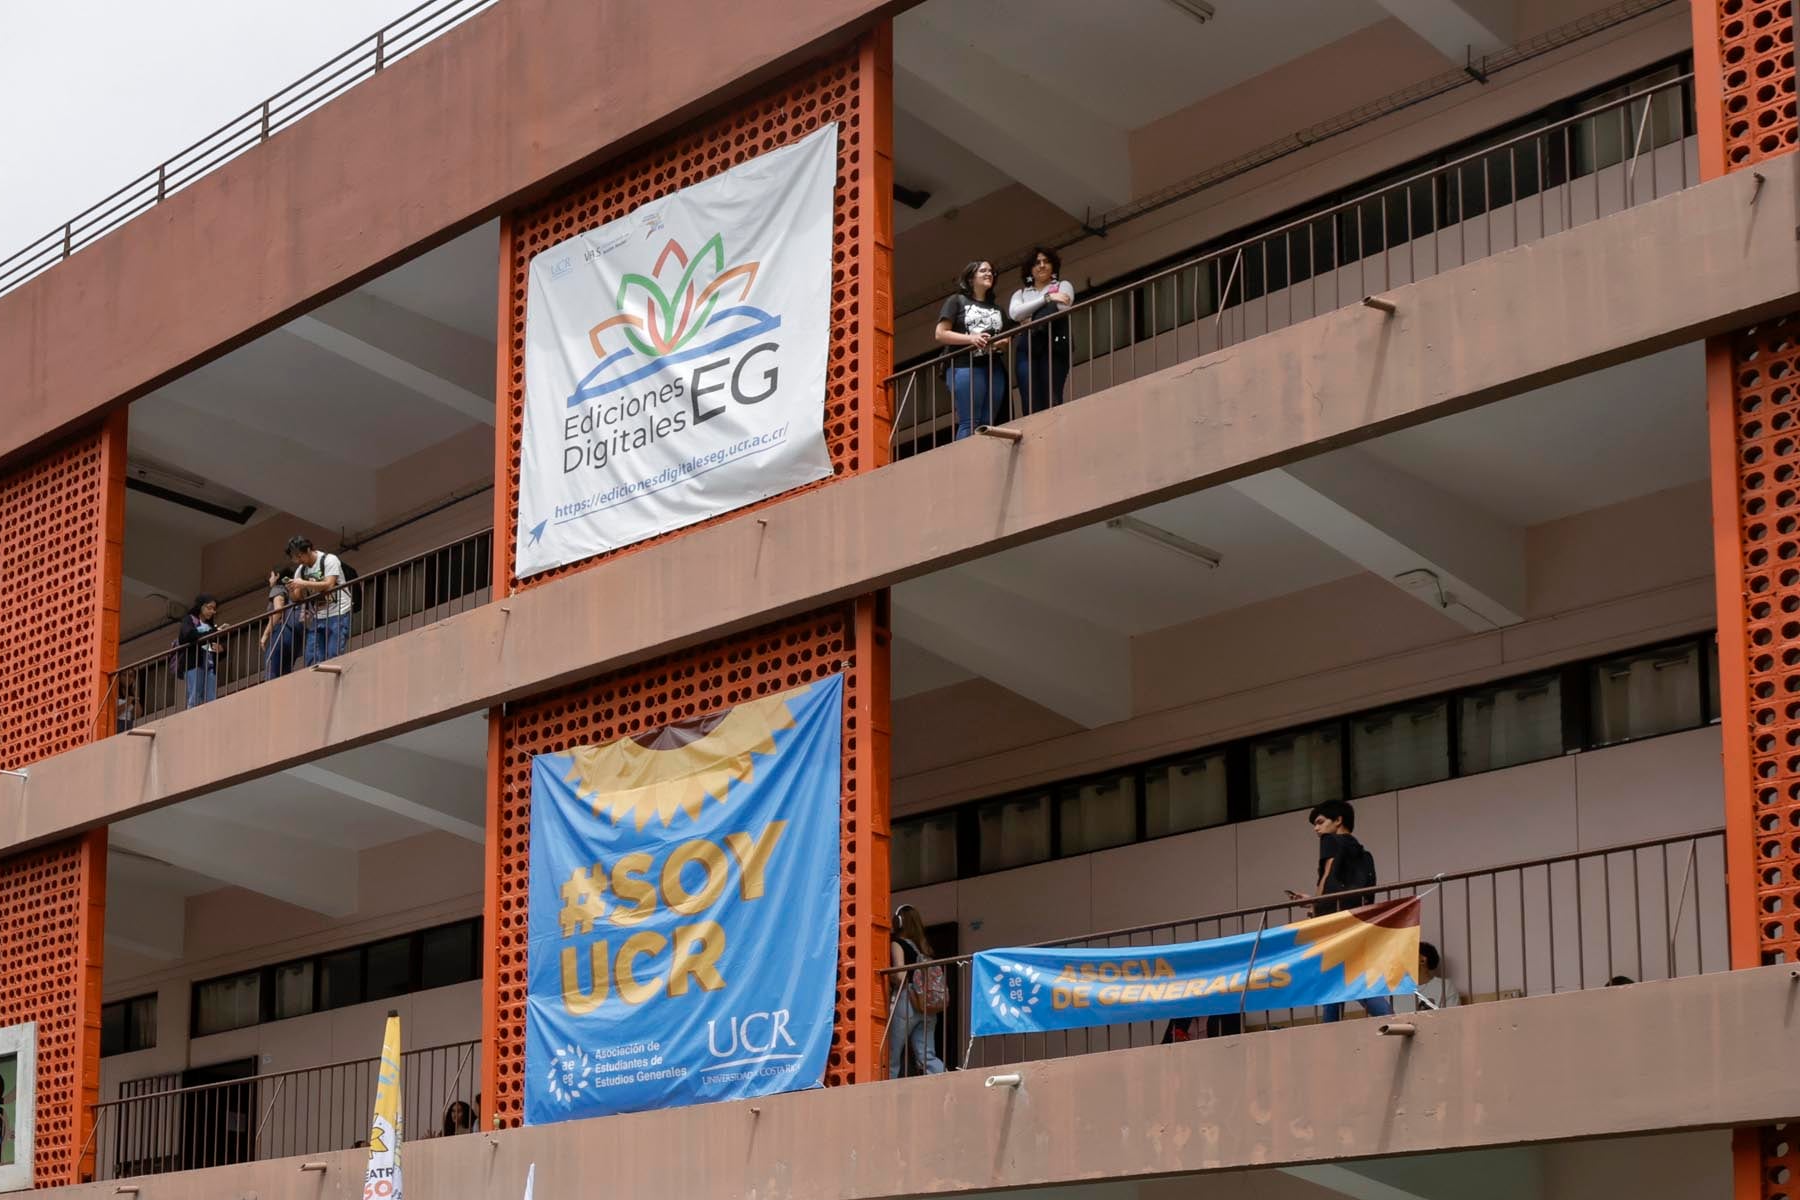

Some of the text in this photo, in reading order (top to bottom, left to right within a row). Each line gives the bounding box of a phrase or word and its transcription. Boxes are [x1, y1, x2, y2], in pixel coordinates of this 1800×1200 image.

[564, 376, 685, 440] Ediciones
[691, 342, 780, 425] EG
[563, 409, 686, 474] Digitales
[554, 422, 790, 519] https://edicionesdigitaleseg.ucr.ac.cr/
[558, 820, 788, 938] #SOY
[560, 921, 727, 1016] UCR
[1052, 963, 1293, 1010] DE GENERALES
[1053, 958, 1176, 983] ASOCIA
[595, 1041, 660, 1059] Asociación de
[707, 1008, 797, 1058] UCR
[595, 1055, 663, 1073] Estudiantes de
[595, 1067, 688, 1088] Estudios Generales
